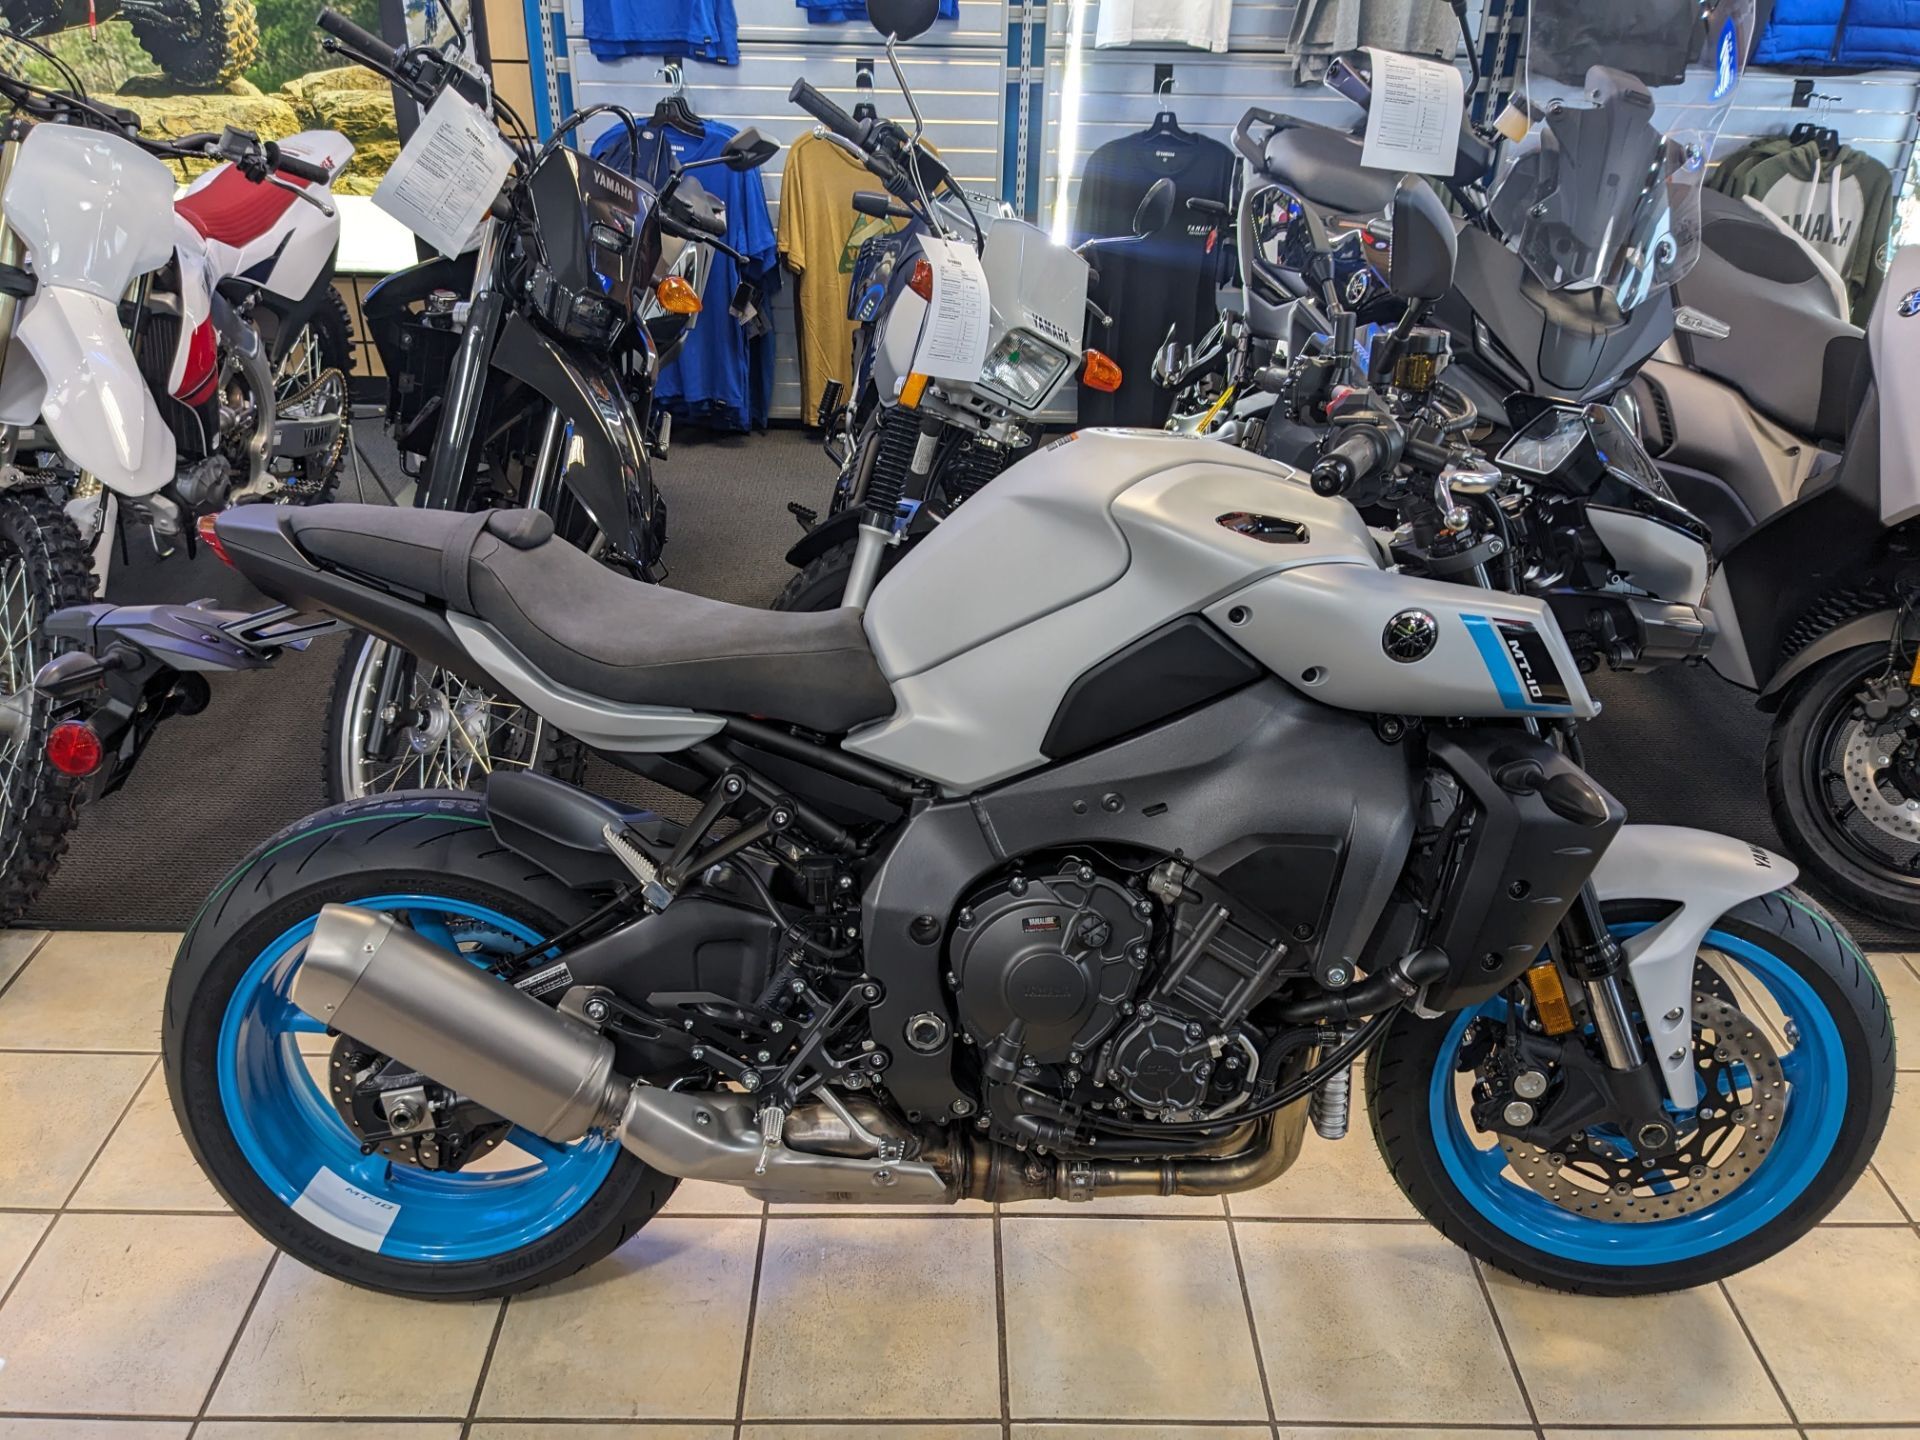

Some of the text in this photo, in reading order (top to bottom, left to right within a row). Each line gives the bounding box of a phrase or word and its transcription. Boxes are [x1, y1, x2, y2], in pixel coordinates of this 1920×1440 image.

[593, 169, 633, 202] YAMAHA
[1032, 313, 1071, 346] YAMAHA
[1508, 640, 1543, 697] MT-10
[345, 1188, 393, 1210] MT-10
